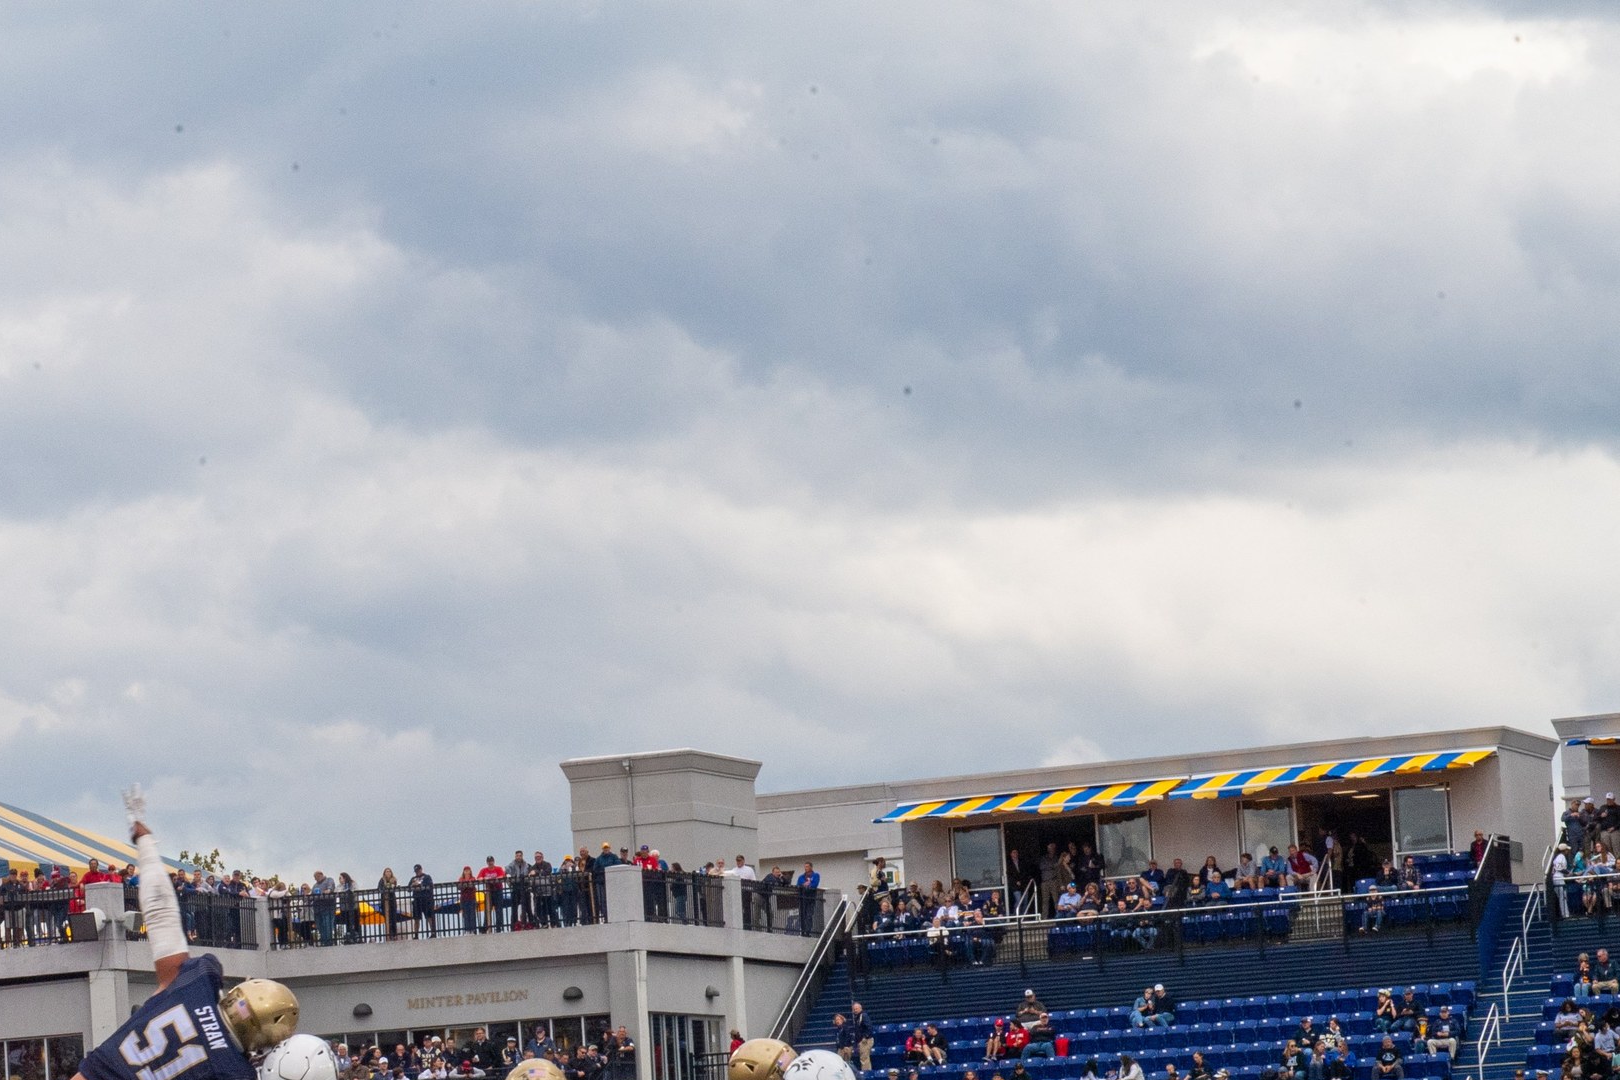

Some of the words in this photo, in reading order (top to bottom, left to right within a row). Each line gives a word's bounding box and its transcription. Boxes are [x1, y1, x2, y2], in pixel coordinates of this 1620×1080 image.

[407, 995, 463, 1010] MINTER
[466, 989, 529, 1005] PAVILION
[194, 1005, 228, 1050] STRAW
